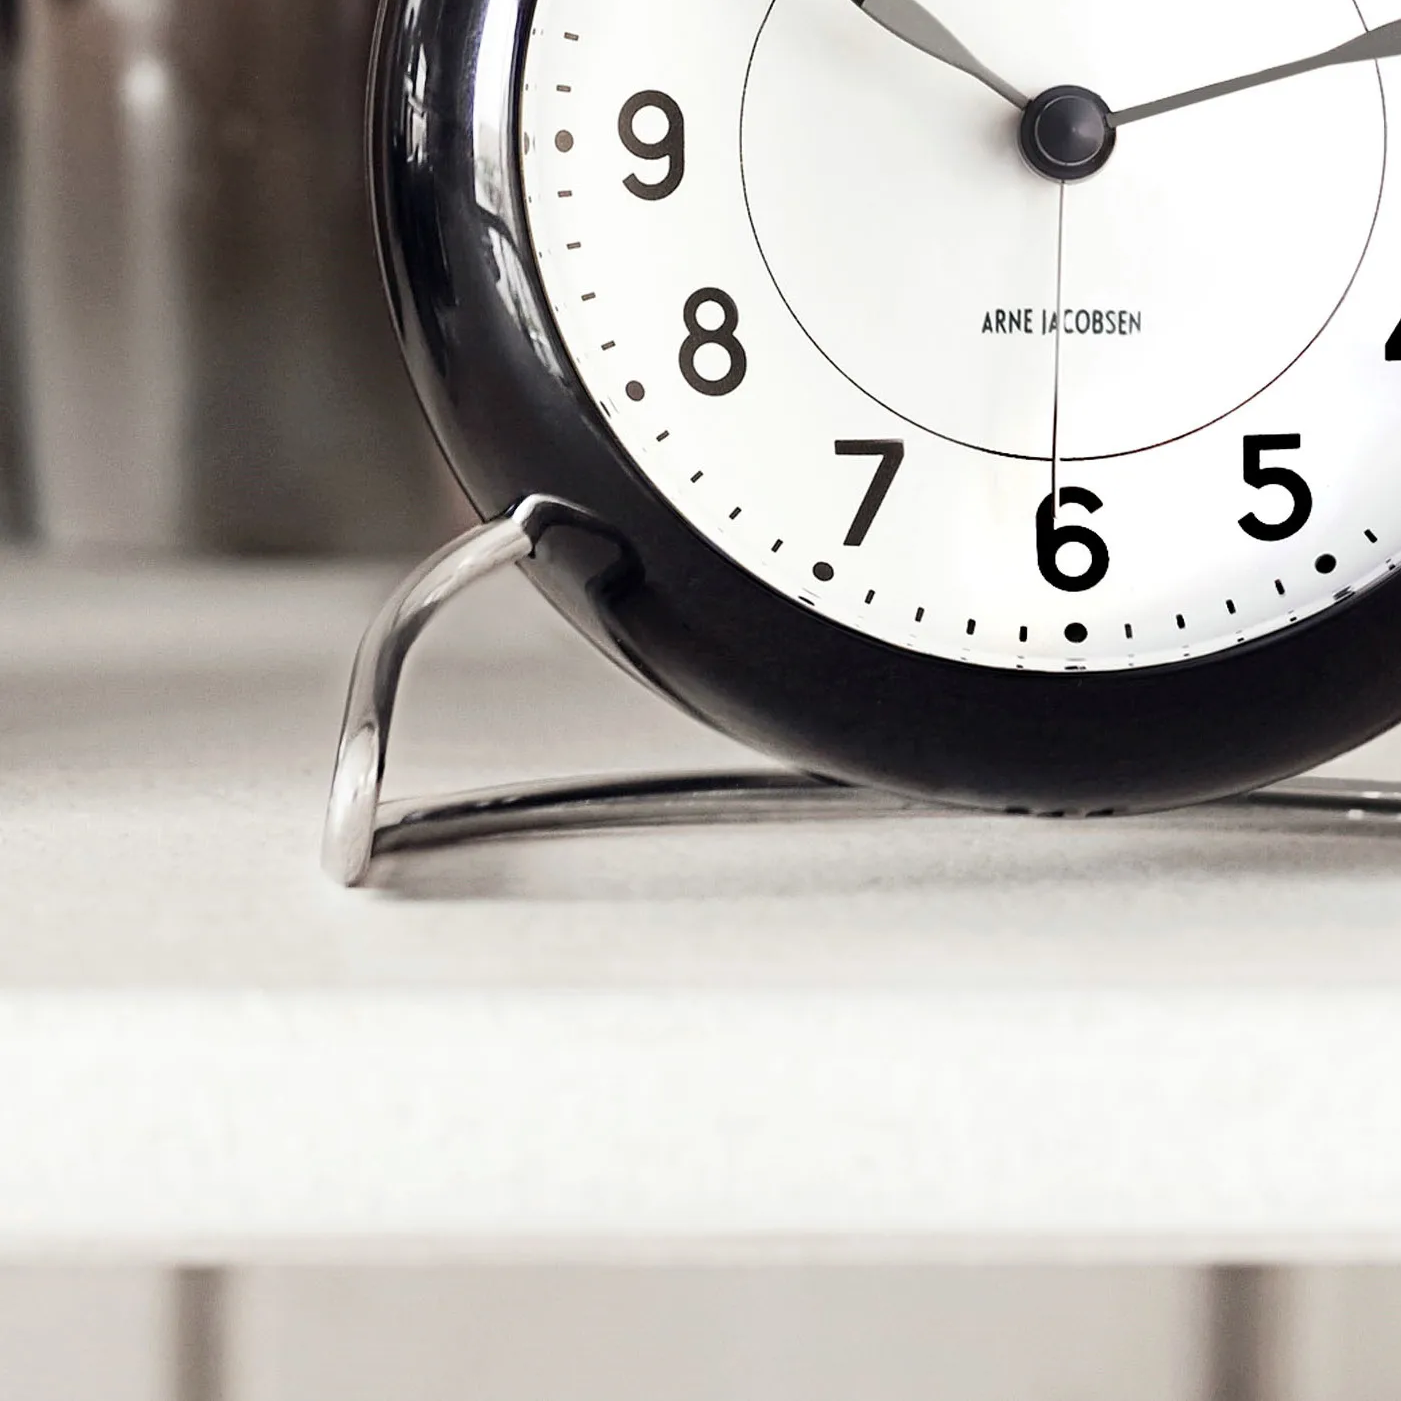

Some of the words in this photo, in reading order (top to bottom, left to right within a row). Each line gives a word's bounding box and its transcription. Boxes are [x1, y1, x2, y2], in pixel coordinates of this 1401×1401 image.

[617, 89, 686, 201] 9
[677, 287, 748, 397] 8
[981, 308, 1034, 335] ARNE
[1041, 308, 1142, 336] JACOBSEN
[834, 439, 904, 547] 7
[1034, 486, 1110, 593] 6
[1237, 432, 1312, 542] 5
